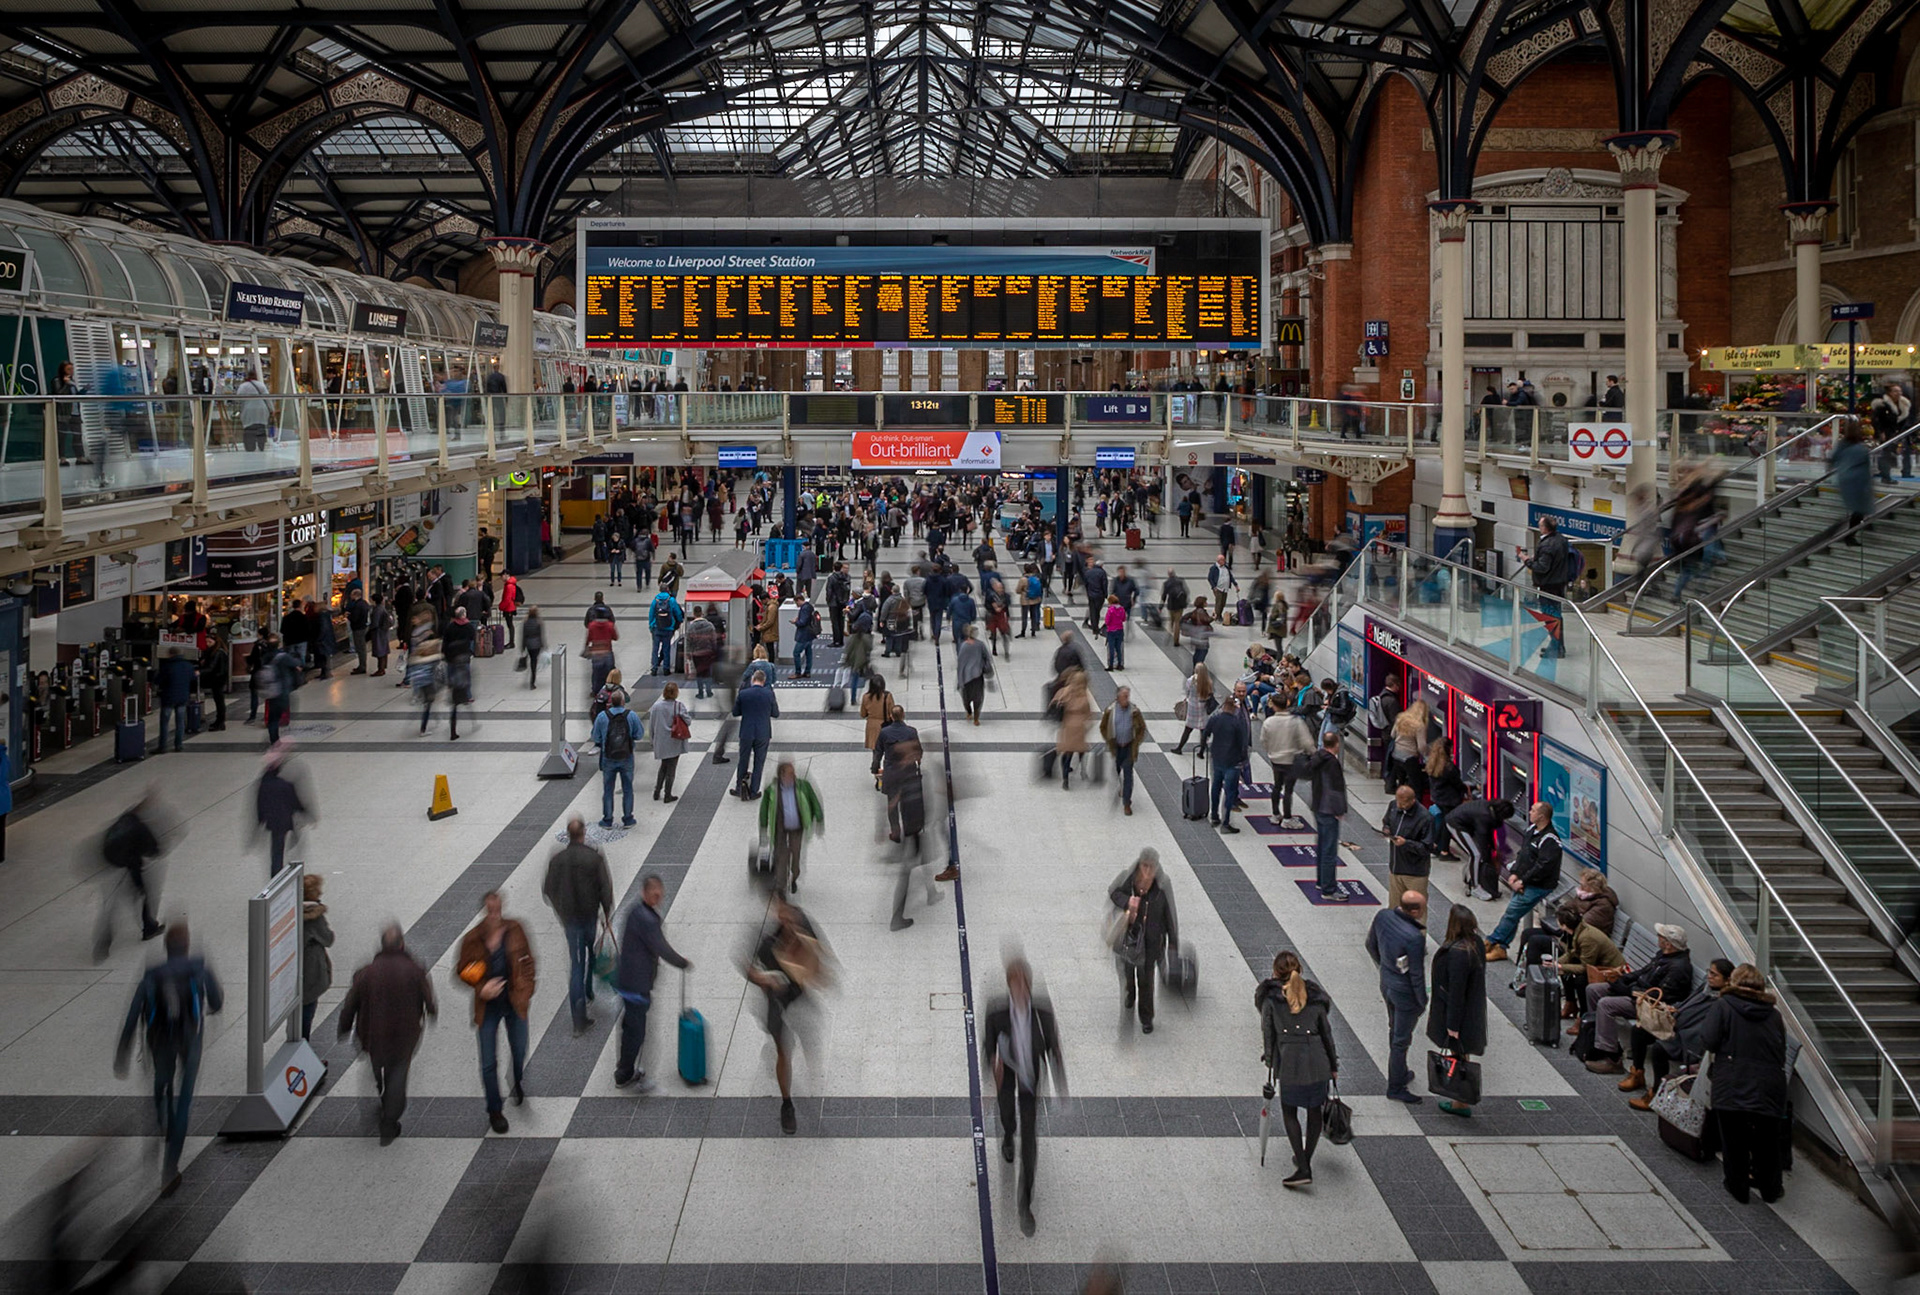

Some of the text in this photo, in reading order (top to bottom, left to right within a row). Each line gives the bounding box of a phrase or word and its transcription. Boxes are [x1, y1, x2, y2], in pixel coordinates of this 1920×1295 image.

[608, 255, 816, 270] Welcome to Liverpool Street Station
[368, 312, 389, 327] LUSH
[1724, 349, 1781, 360] Isle of Flowers
[1829, 347, 1847, 356] Isle
[1863, 348, 1902, 356] Flowers
[1104, 405, 1118, 414] Lift
[870, 442, 954, 458] Out-brilliant.
[344, 506, 360, 516] PASTY
[1568, 518, 1590, 532] STREET
[291, 522, 328, 544] COFFE
[195, 536, 204, 556] 5
[1372, 625, 1402, 655] NatWest
